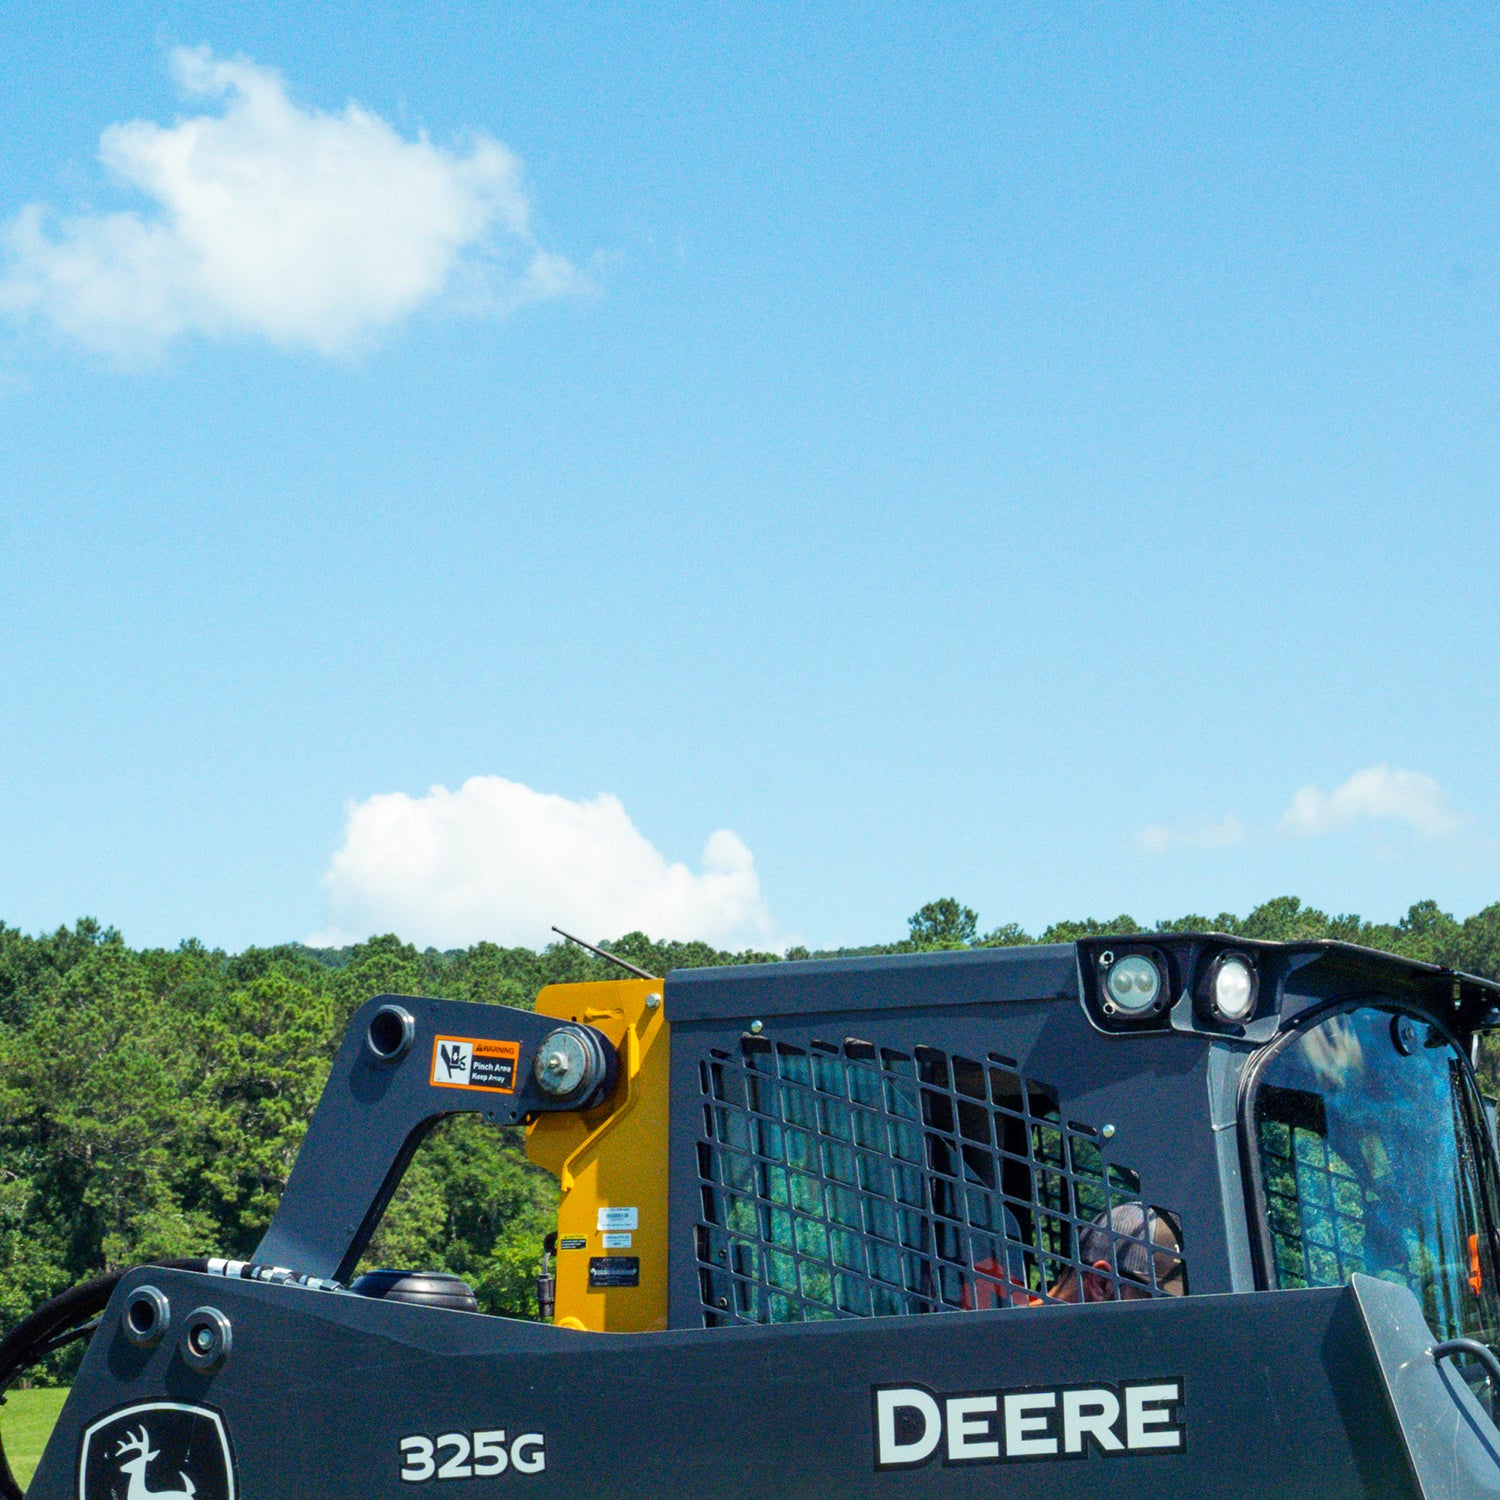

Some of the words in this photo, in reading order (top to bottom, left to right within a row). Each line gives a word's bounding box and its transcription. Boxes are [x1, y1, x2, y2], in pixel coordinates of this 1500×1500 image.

[483, 1044, 515, 1055] WARNING
[473, 1061, 494, 1072] Pinch
[494, 1063, 512, 1073] Area
[471, 1072, 488, 1082] Keep
[488, 1074, 506, 1084] Away
[877, 1383, 1181, 1465] DEERE
[400, 1429, 546, 1482] 325G
